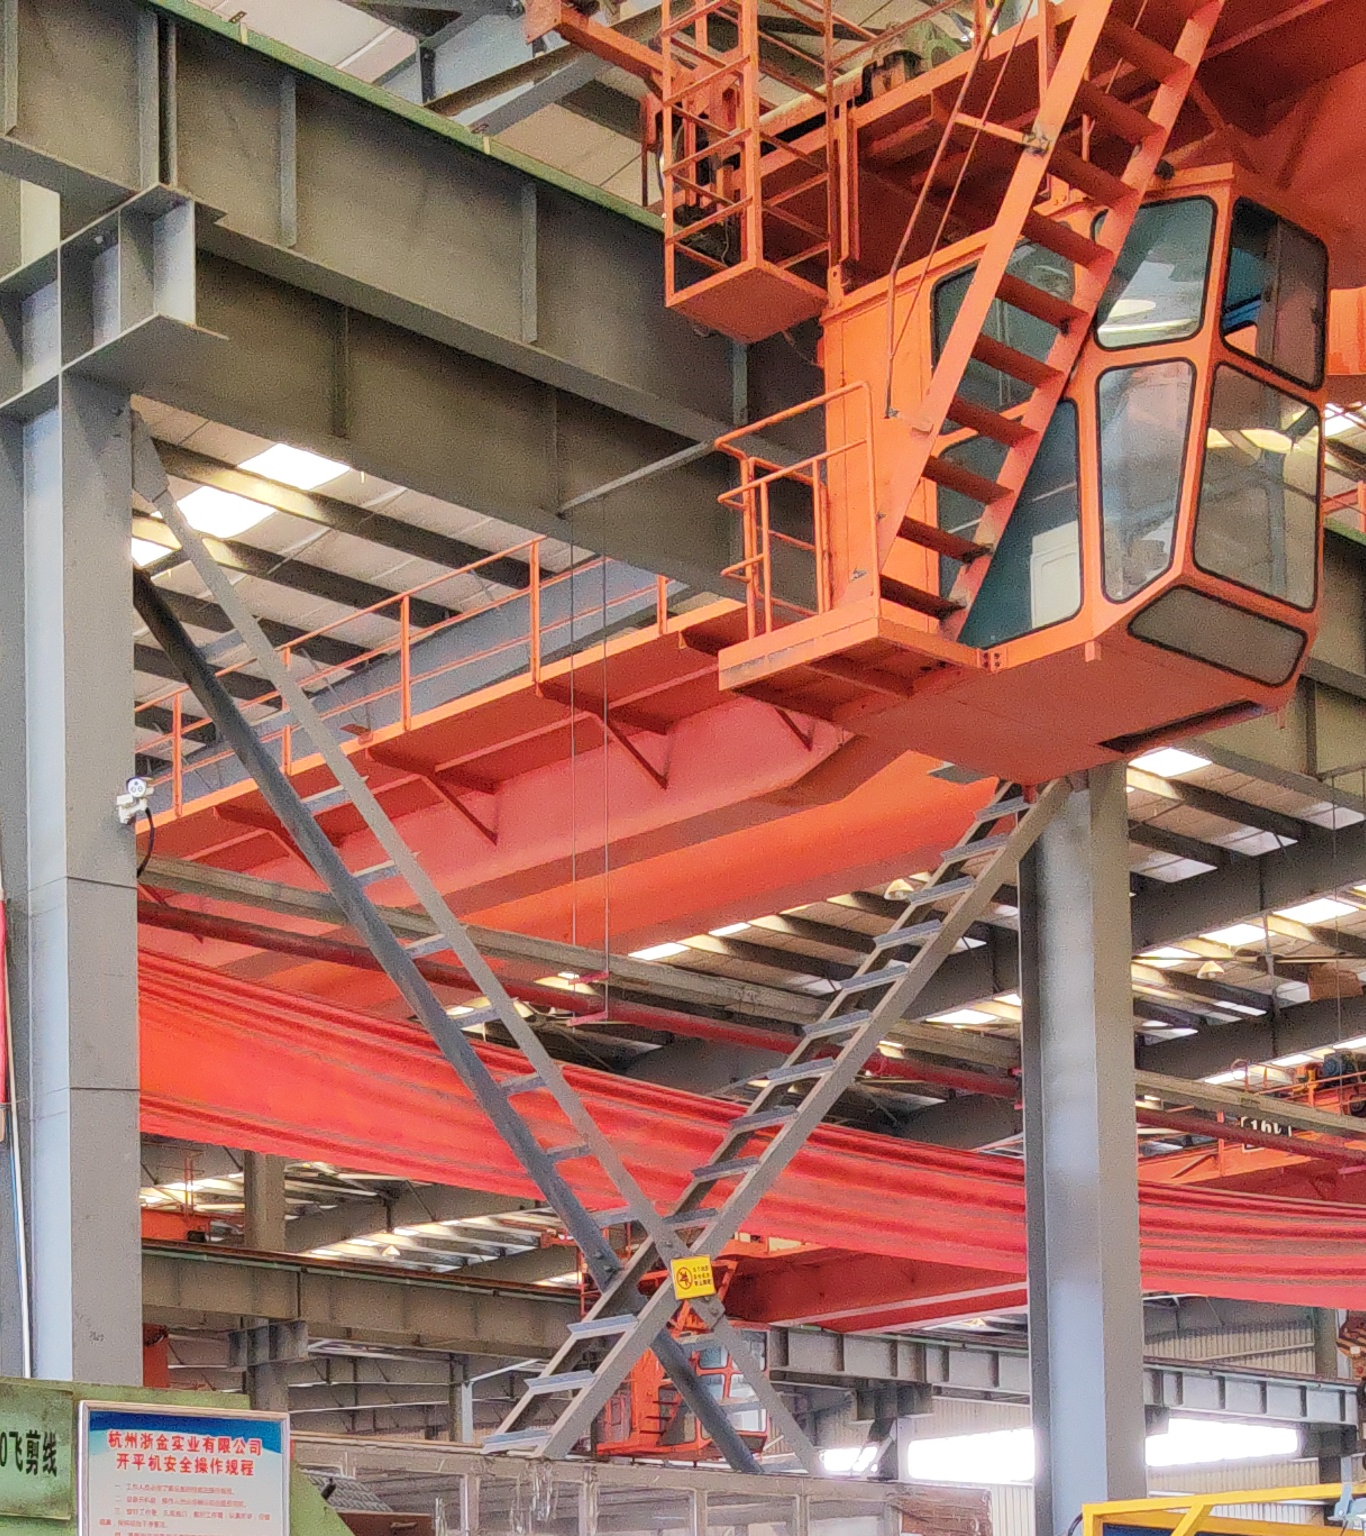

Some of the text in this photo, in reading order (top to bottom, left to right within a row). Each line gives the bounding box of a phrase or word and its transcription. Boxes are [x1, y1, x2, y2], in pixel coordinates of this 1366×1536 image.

[107, 1430, 262, 1457] 杭州浙金实业有限公司
[117, 1453, 255, 1476] 开平机安全操作规程
